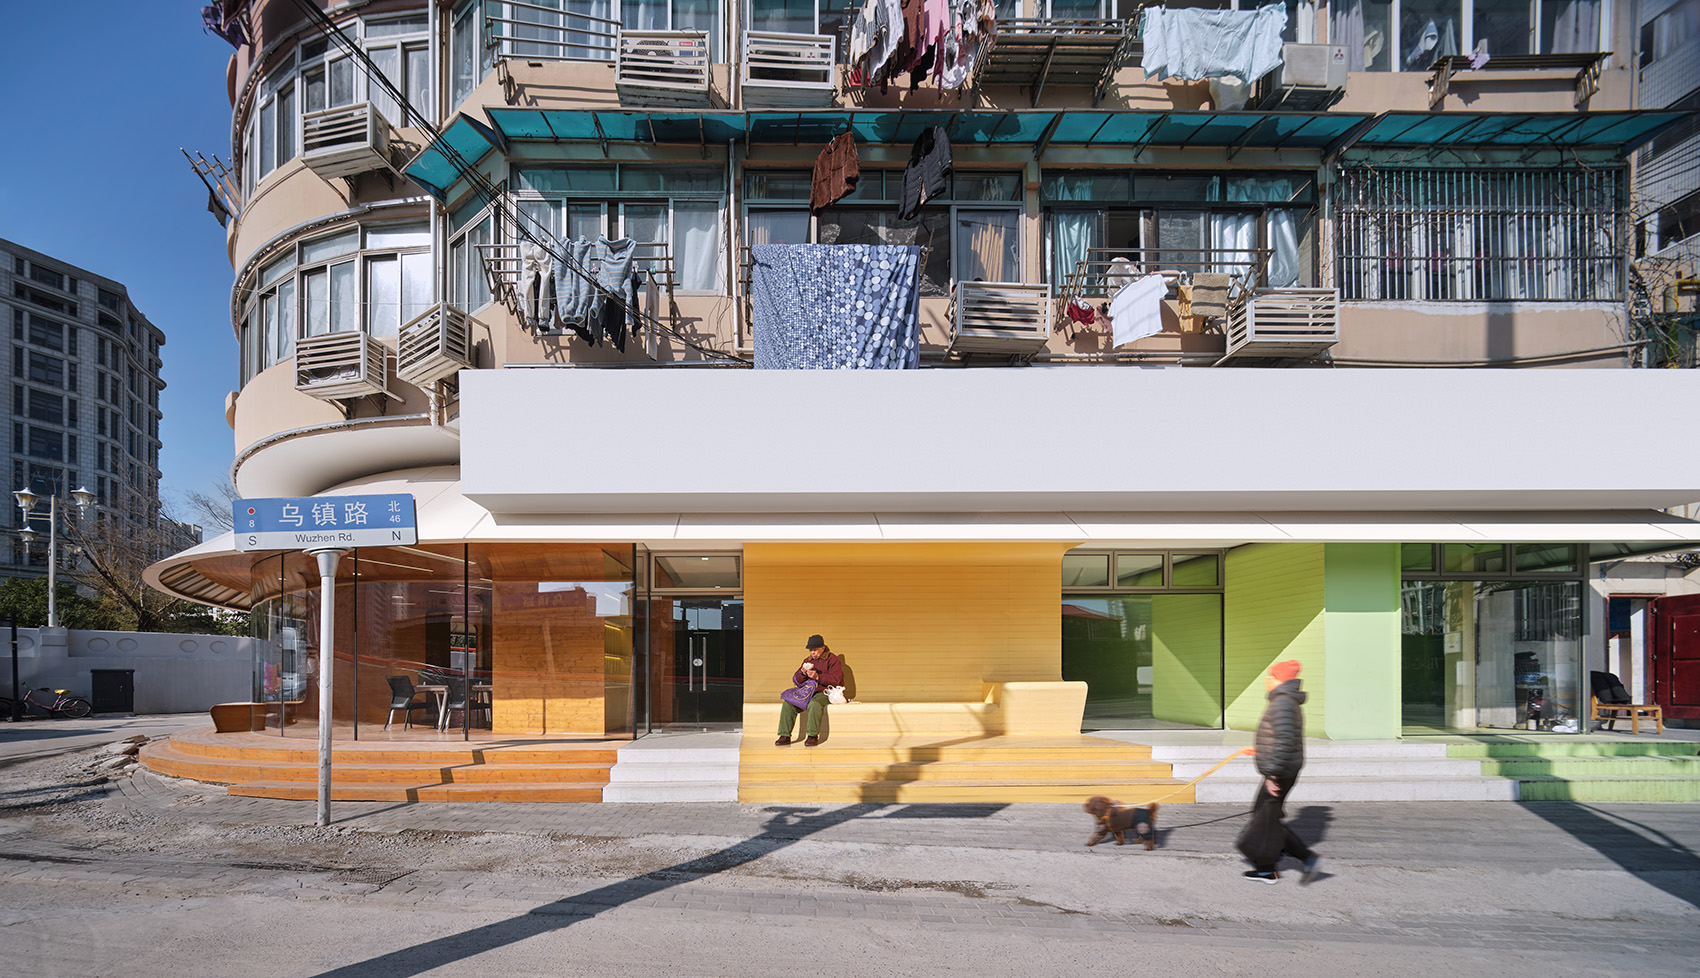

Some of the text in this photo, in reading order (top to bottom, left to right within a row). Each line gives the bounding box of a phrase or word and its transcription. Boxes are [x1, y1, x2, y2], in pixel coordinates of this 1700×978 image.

[388, 500, 400, 512] 北
[279, 501, 368, 526] 乌镇路
[389, 515, 401, 523] 46
[249, 519, 255, 527] 8
[248, 535, 257, 546] S
[295, 532, 355, 543] Wuzhen Rd.
[392, 531, 401, 541] N
